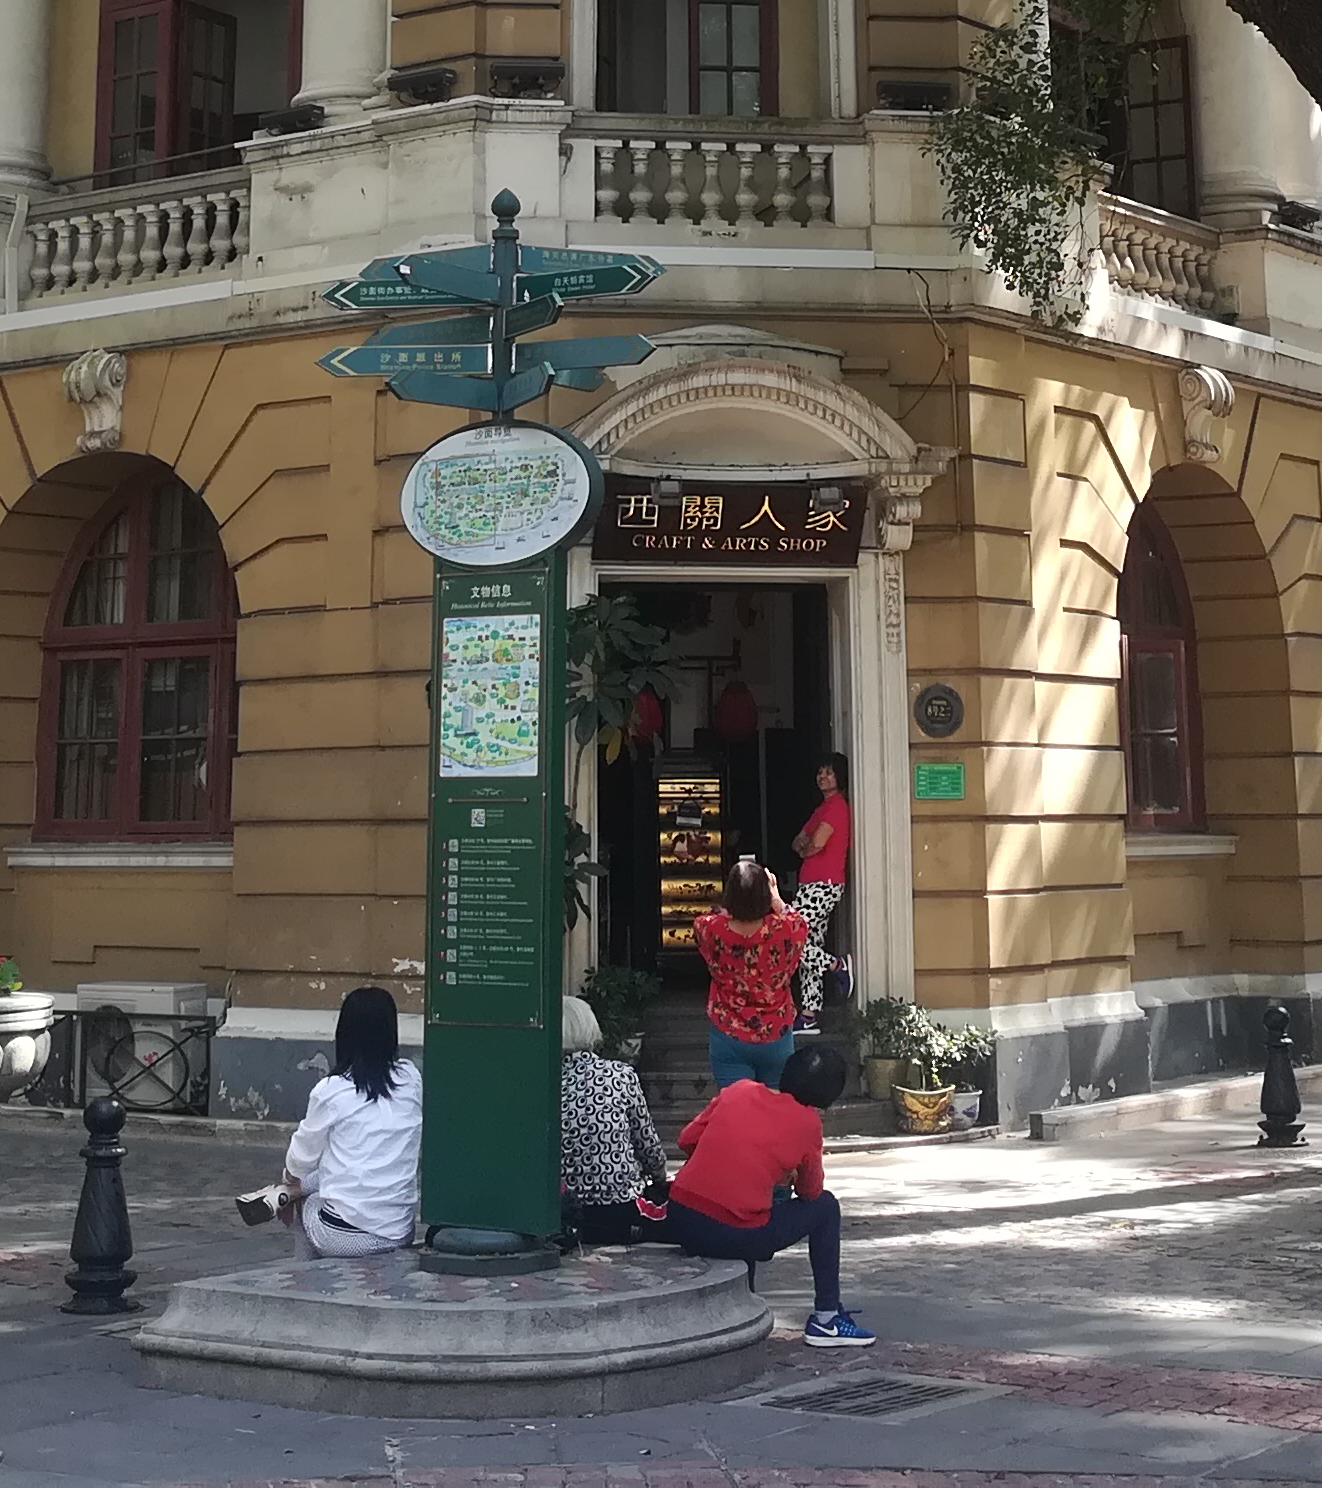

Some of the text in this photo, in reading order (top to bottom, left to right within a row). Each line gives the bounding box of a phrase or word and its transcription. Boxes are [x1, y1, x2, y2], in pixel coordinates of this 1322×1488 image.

[616, 495, 850, 531] 西關人家
[632, 533, 827, 552] CRAFT & ARTS SHOP
[470, 584, 512, 599] 文物信息
